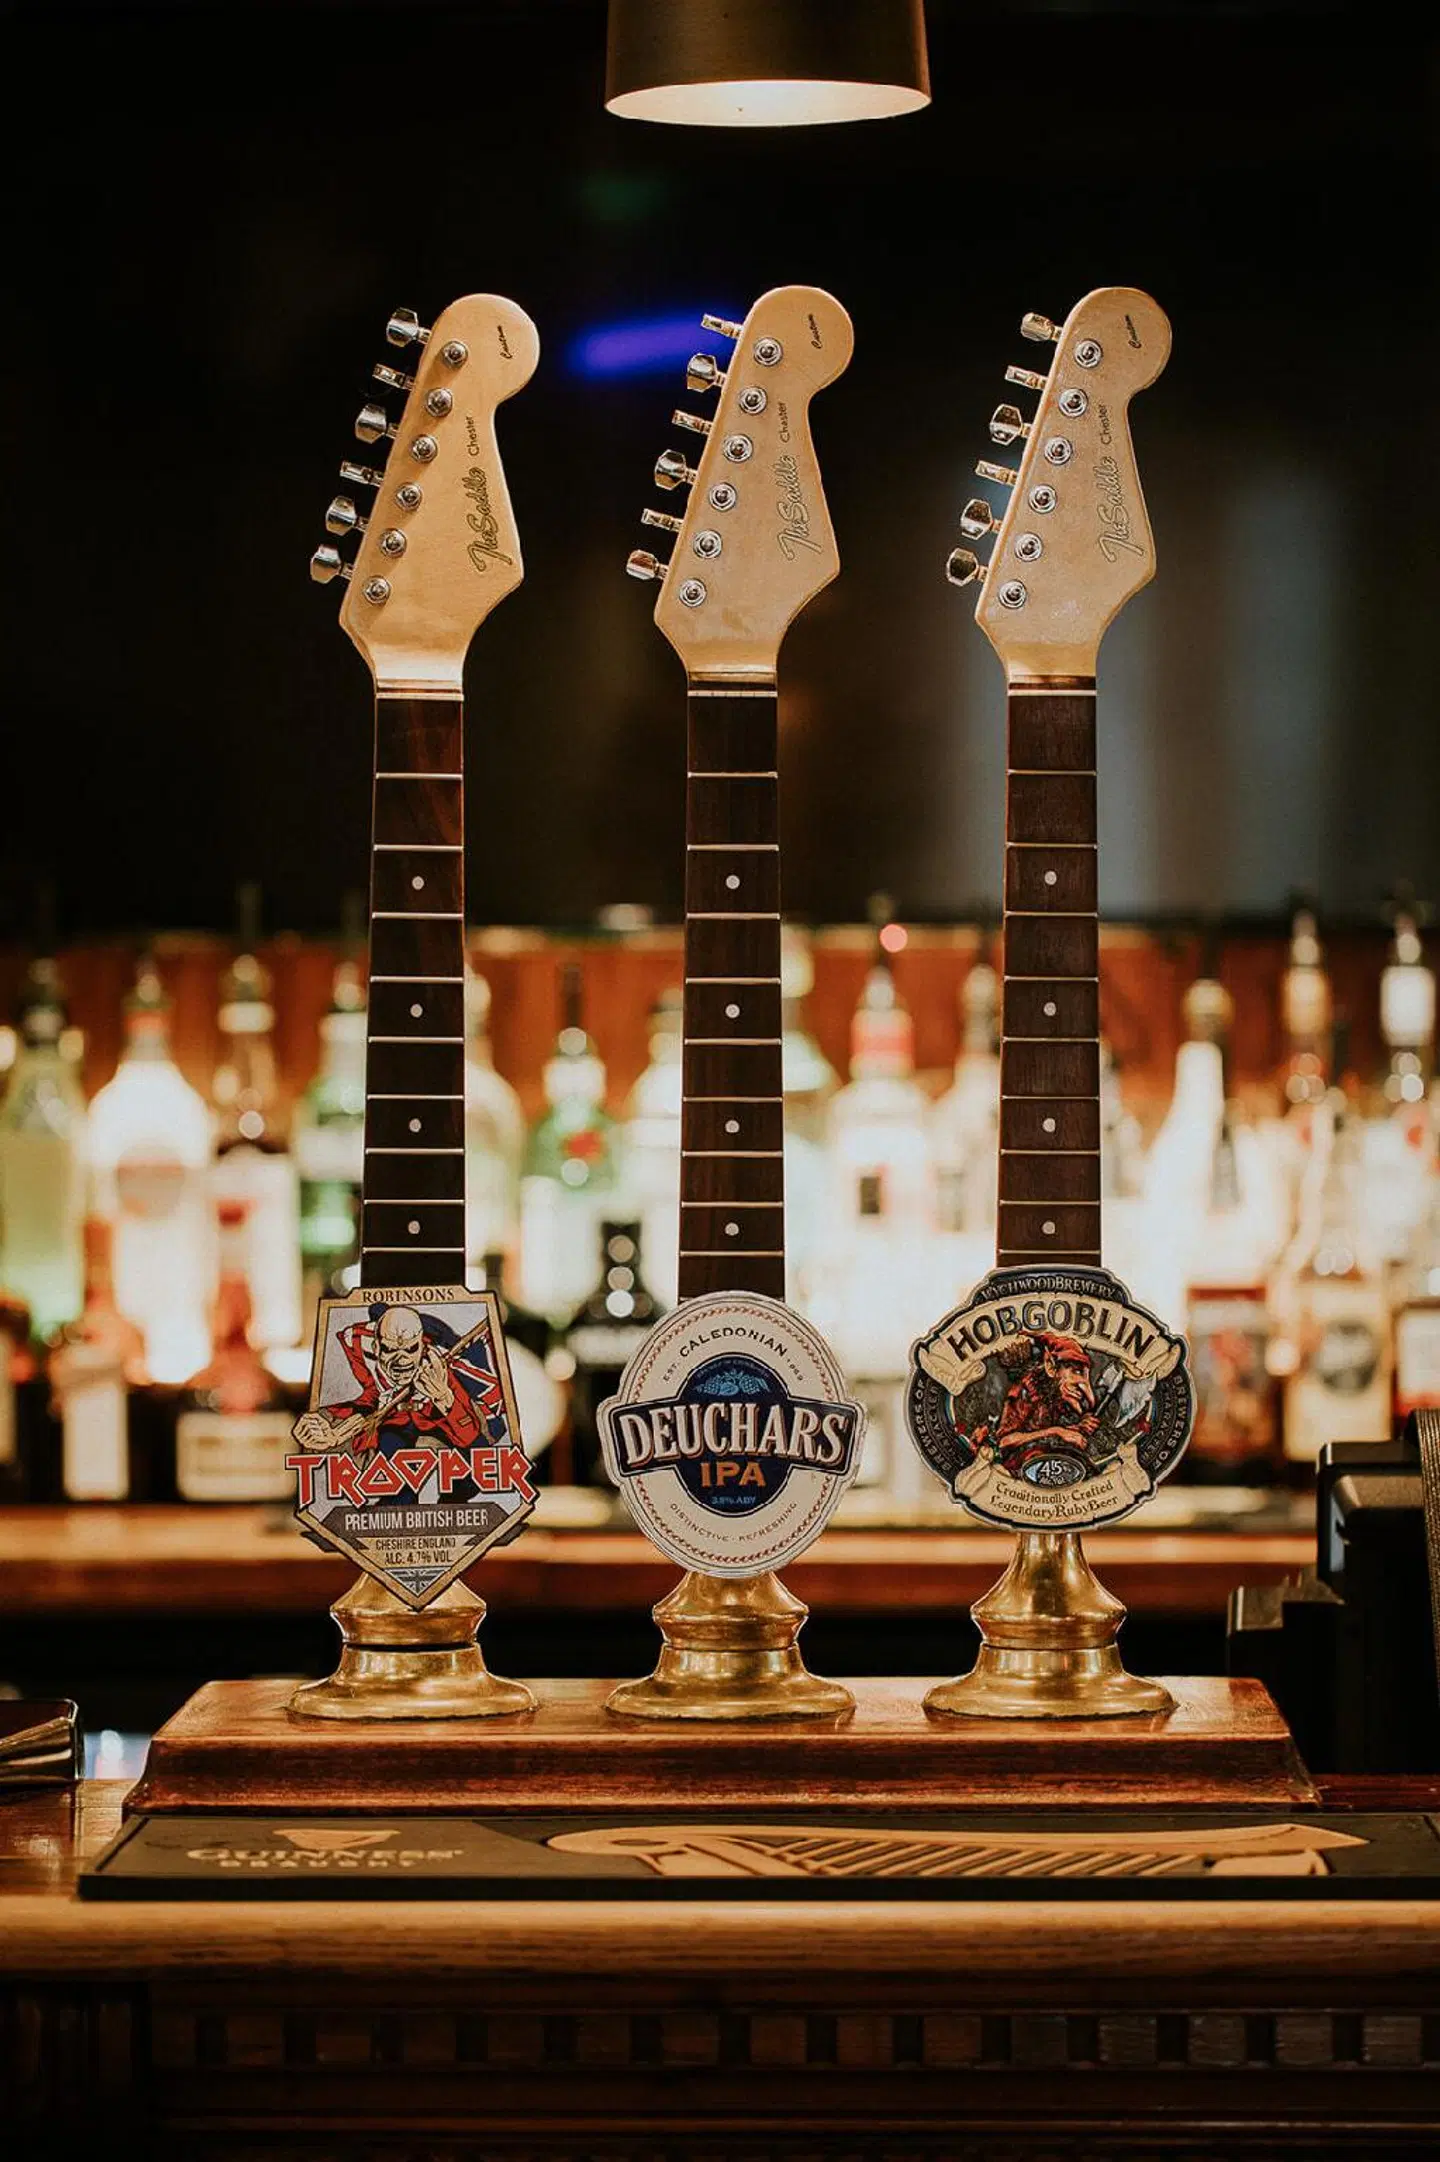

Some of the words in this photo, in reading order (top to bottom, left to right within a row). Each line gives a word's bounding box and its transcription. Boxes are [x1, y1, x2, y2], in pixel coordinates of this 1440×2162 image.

[466, 415, 480, 456] Chester
[778, 401, 791, 443] Chester
[1098, 403, 1112, 445] Chester
[362, 1287, 455, 1302] ROBINSONS
[680, 1327, 788, 1357] CALEDONIAN
[947, 1300, 1155, 1362] HOBGOBLIN
[618, 1402, 848, 1468] DEUCHARS
[285, 1446, 539, 1508] TROOPER
[701, 1461, 766, 1488] IPA
[1071, 1480, 1114, 1501] Crafted
[344, 1513, 403, 1530] PREMIUM
[406, 1510, 453, 1529] BRITISH
[456, 1509, 489, 1526] BEER
[990, 1495, 1054, 1519] Legendary
[1054, 1500, 1089, 1518] Ruby
[1088, 1496, 1118, 1512] Beer
[375, 1539, 417, 1551] CHESHIRE
[418, 1537, 456, 1549] ENGLAND
